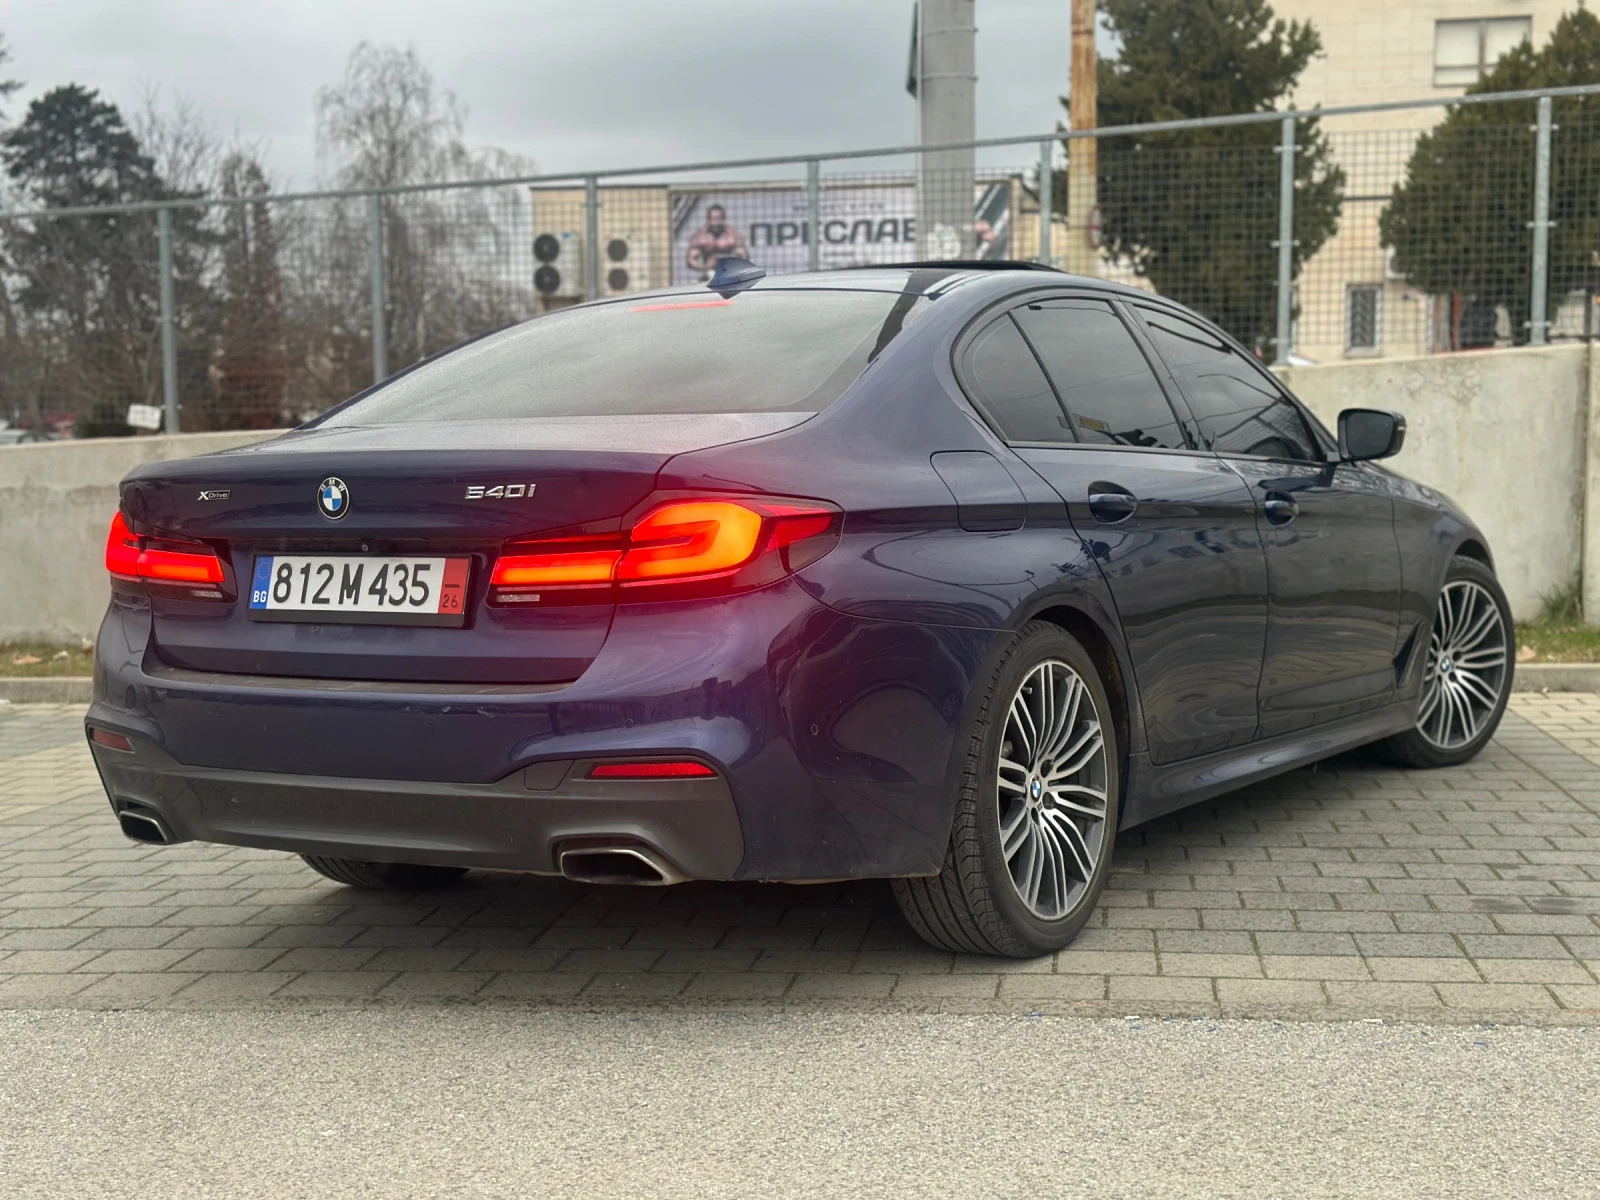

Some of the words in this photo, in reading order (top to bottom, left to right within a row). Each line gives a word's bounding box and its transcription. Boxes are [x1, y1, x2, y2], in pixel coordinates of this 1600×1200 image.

[465, 484, 536, 499] 540i
[253, 590, 267, 603] BG
[442, 594, 458, 608] 26
